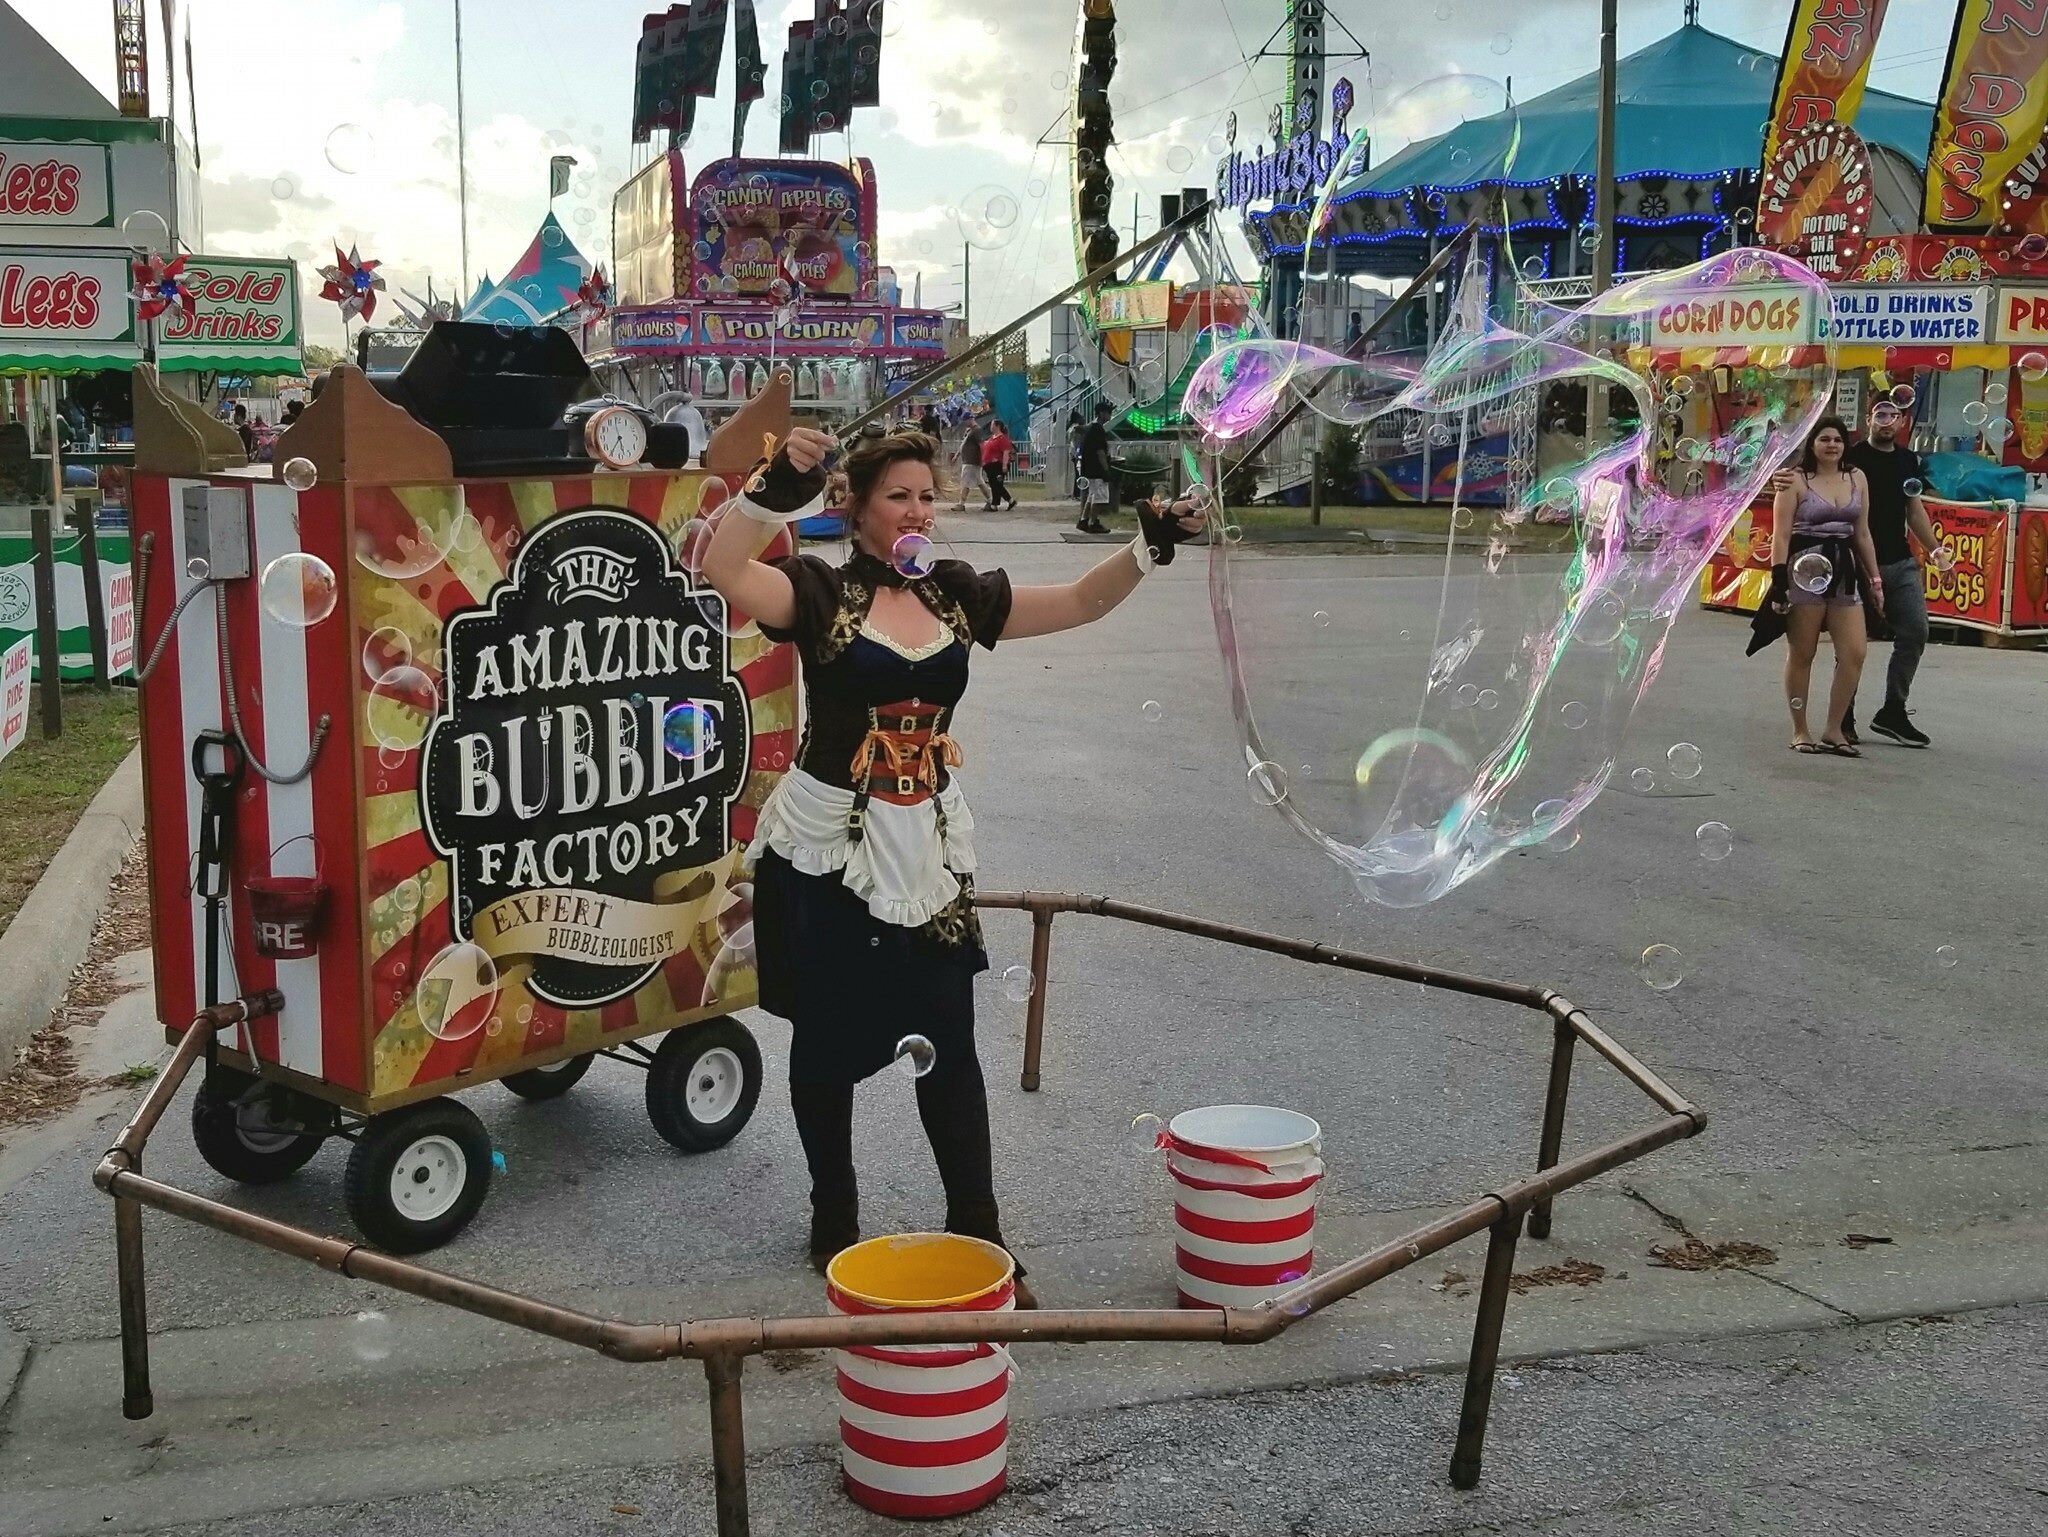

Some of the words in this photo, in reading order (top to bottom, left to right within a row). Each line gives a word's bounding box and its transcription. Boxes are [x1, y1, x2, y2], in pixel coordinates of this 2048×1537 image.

[1768, 136, 1829, 214] PRONTO
[1833, 139, 1866, 205] PUPS
[713, 187, 774, 207] CANDY
[781, 189, 848, 210] APPLES
[1802, 216, 1825, 235] HOT
[1824, 213, 1848, 232] DOG
[1810, 236, 1826, 254] ON
[1826, 234, 1834, 252] A
[1945, 247, 1976, 264] FAMILY
[734, 261, 782, 280] CARAME
[797, 261, 828, 280] PPLES
[1806, 254, 1838, 273] STICK
[1, 264, 101, 328] Legs
[1828, 293, 1880, 314] COLD
[1888, 292, 1973, 314] DRINKS
[165, 307, 284, 342] Drinks
[725, 318, 860, 341] POPCORN
[1658, 300, 1726, 334] CORN
[1729, 297, 1801, 332] DOGS
[1818, 317, 1906, 340] BOTTLED
[1909, 317, 1980, 340] WATER
[556, 553, 626, 595] THE
[1924, 562, 1985, 613] Dogs
[110, 575, 133, 609] CAME
[111, 608, 133, 647] RIDES
[4, 645, 29, 682] CAMEL
[467, 614, 713, 700] AMAZING
[6, 679, 24, 712] RIDE
[453, 696, 726, 820] BUBBLE
[476, 795, 709, 890] FACTORY
[489, 893, 616, 938] EXPERT
[546, 925, 675, 959] BUBBLEOLOGIST
